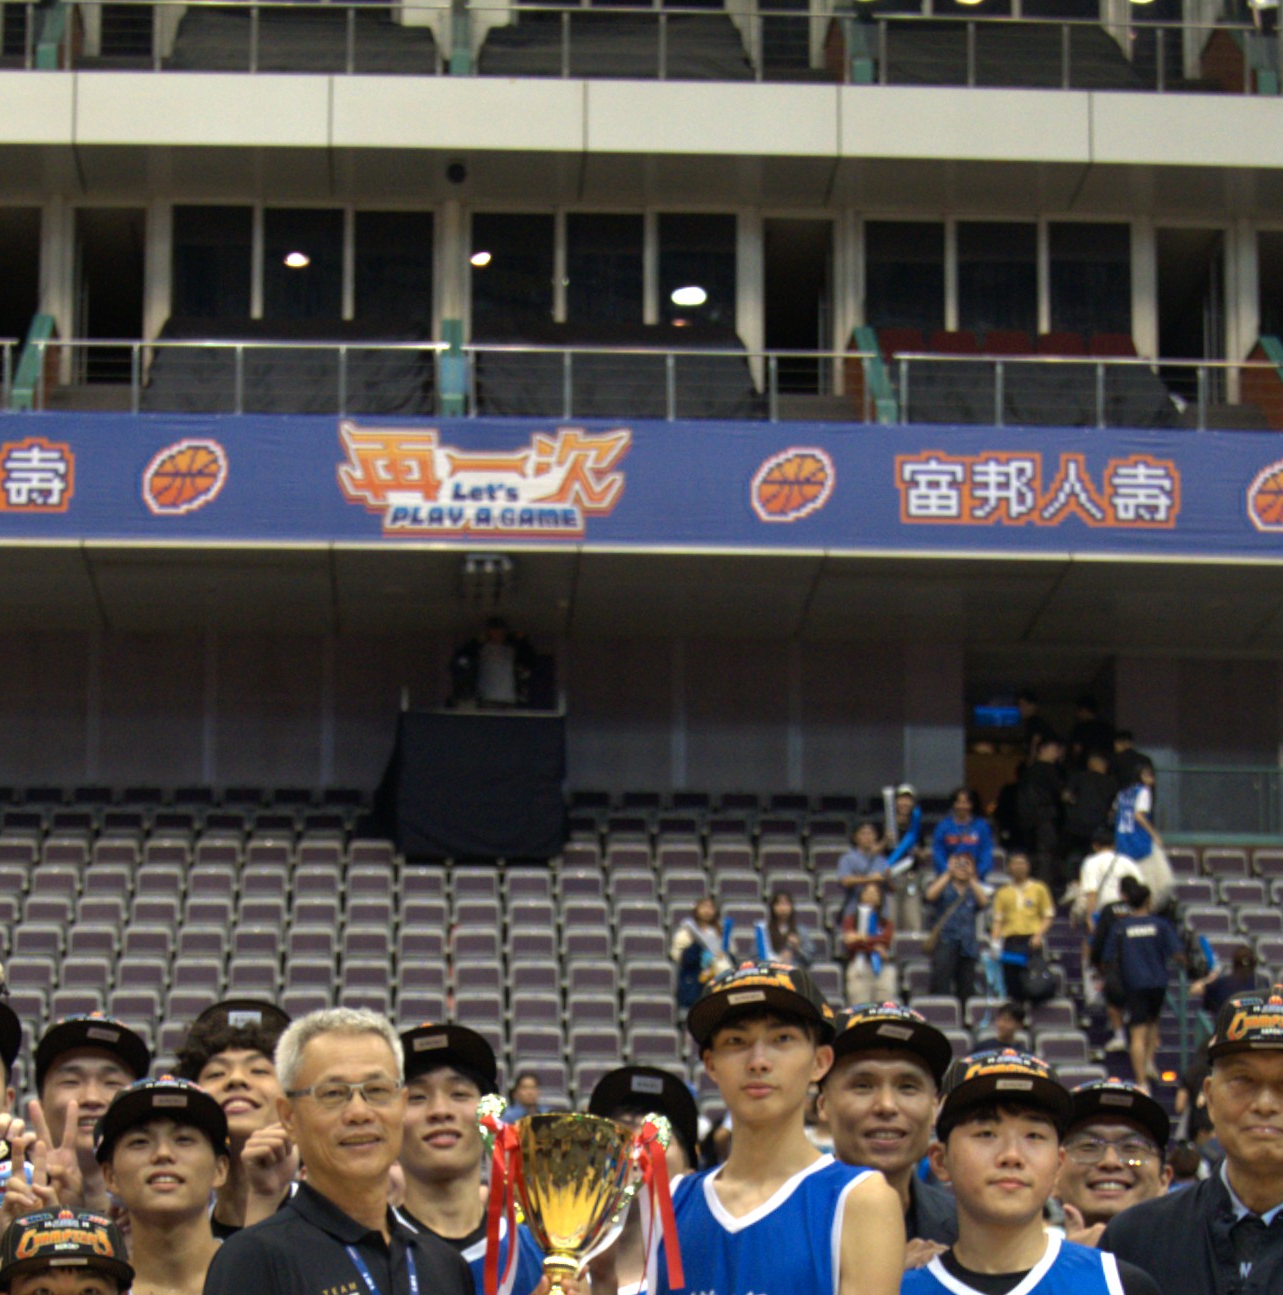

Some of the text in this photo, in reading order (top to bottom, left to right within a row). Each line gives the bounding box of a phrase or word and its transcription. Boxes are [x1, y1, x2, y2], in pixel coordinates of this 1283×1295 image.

[451, 482, 520, 502] Let's
[901, 458, 1175, 522] 富邦人壽
[390, 506, 579, 528] PLAY A GAME
